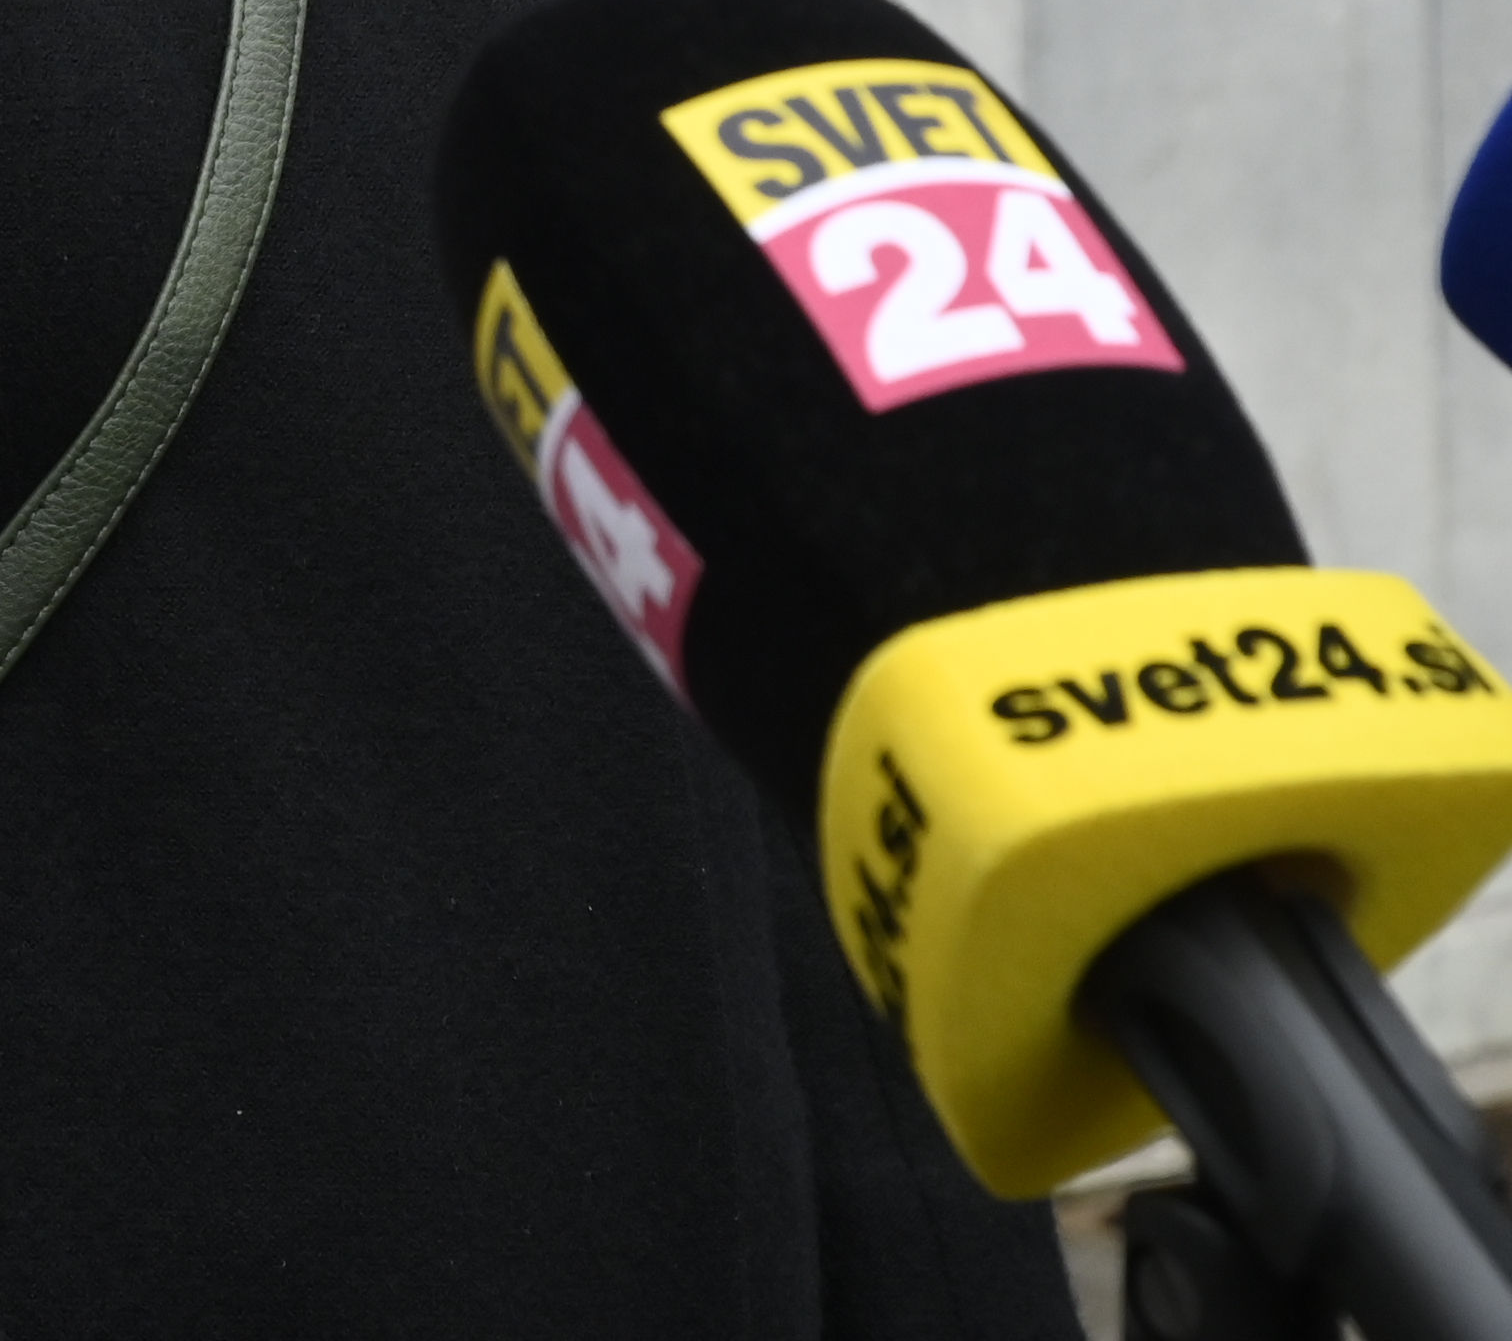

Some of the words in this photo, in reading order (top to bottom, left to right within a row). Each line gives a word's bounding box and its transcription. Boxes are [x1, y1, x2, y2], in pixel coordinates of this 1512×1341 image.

[717, 83, 1013, 201] SVET
[810, 189, 1140, 384] 24
[991, 620, 1496, 746] svet24.si
